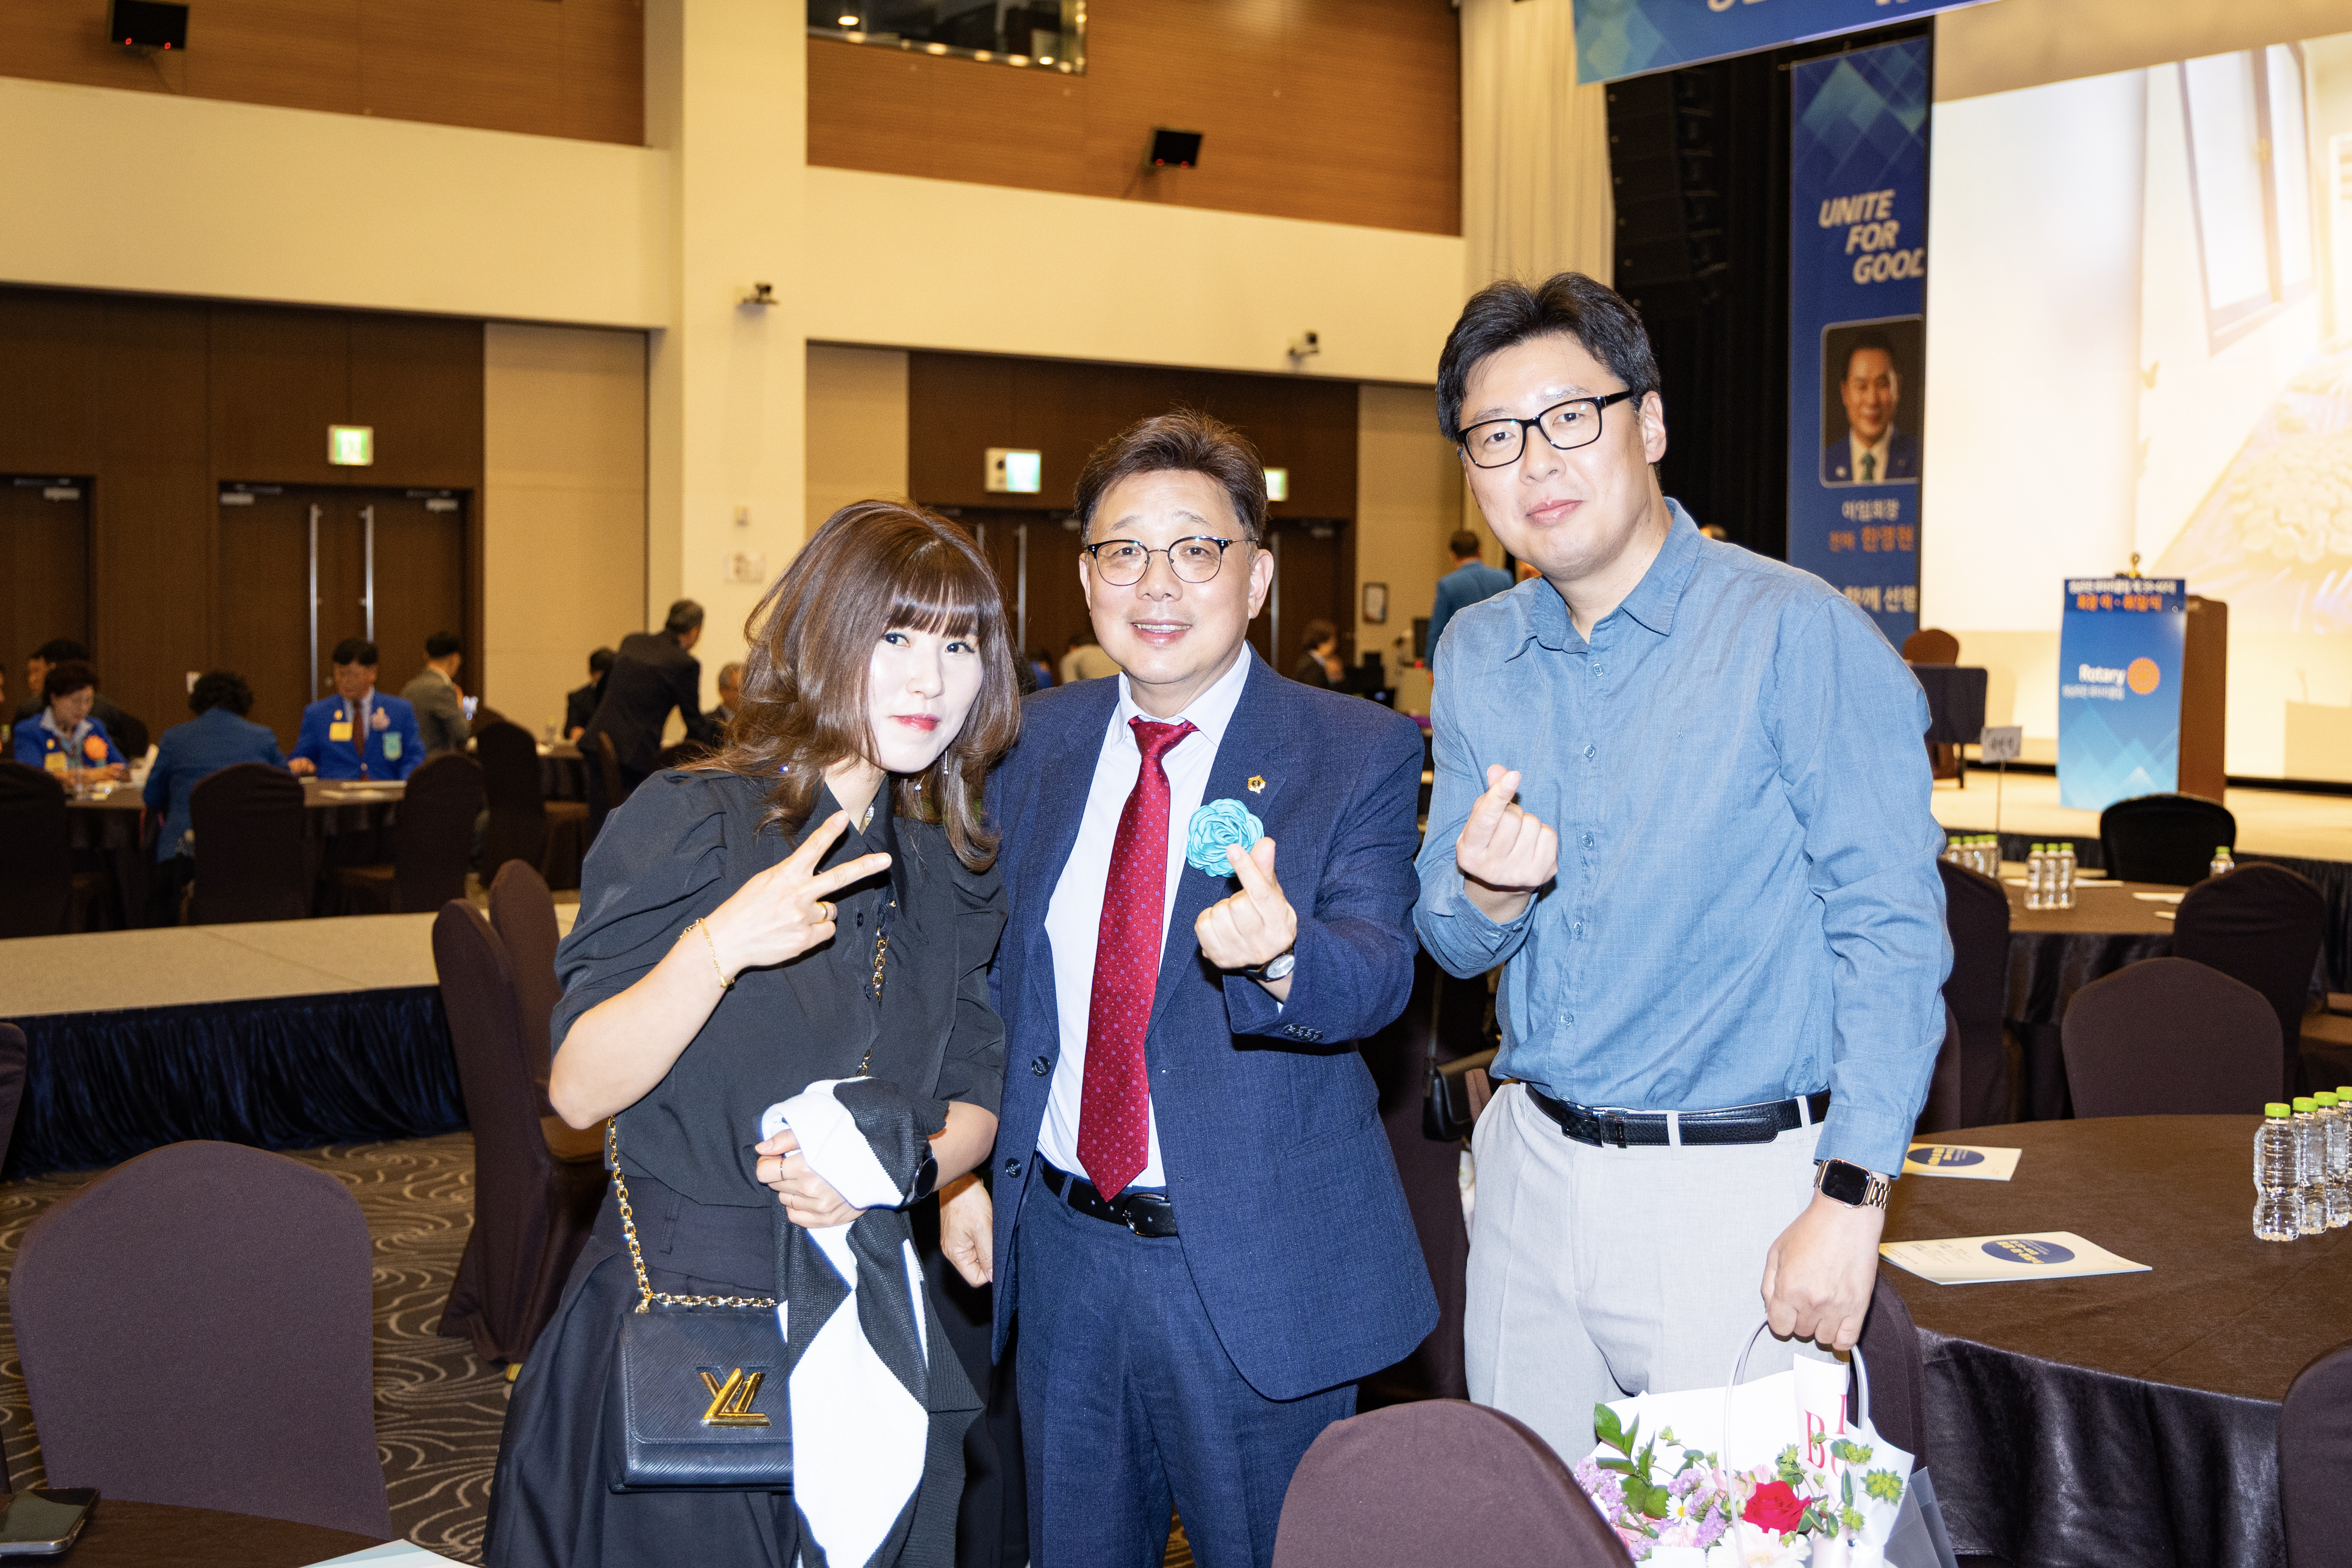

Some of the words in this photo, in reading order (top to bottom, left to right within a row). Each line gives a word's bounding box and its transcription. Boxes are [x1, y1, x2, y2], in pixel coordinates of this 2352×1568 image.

[1819, 189, 1896, 228] UNITE
[1845, 220, 1900, 255] FOR
[2079, 664, 2126, 686] Rotary
